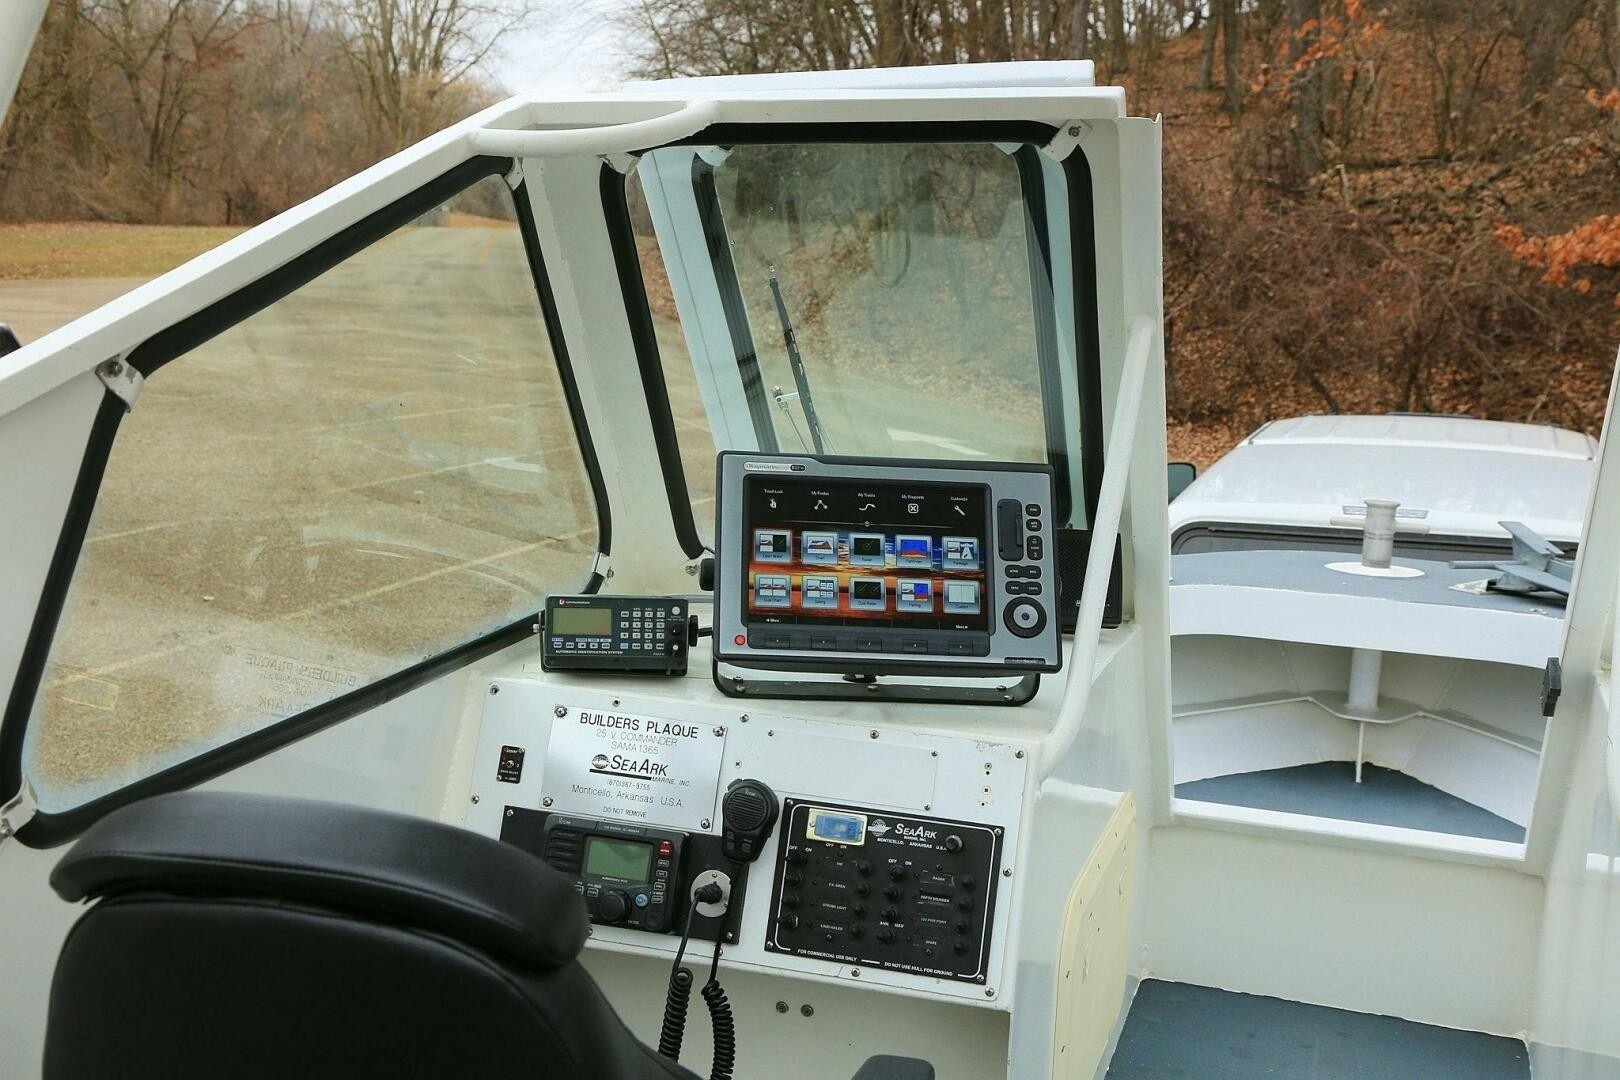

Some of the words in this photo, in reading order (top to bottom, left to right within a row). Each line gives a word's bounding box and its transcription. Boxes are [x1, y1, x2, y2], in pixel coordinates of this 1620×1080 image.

[580, 712, 640, 731] BUILDERS
[646, 721, 700, 739] PLAQUE
[596, 728, 607, 738] 25
[610, 730, 619, 739] V
[620, 731, 678, 747] COMMANDER
[571, 784, 613, 799] Monticello,
[616, 790, 654, 804] Arkansas
[603, 806, 612, 814] DO
[612, 807, 624, 815] NOT
[625, 809, 648, 818] REMOVE
[909, 841, 932, 849] ARKANSAS
[807, 950, 834, 958] COMMERCIAL
